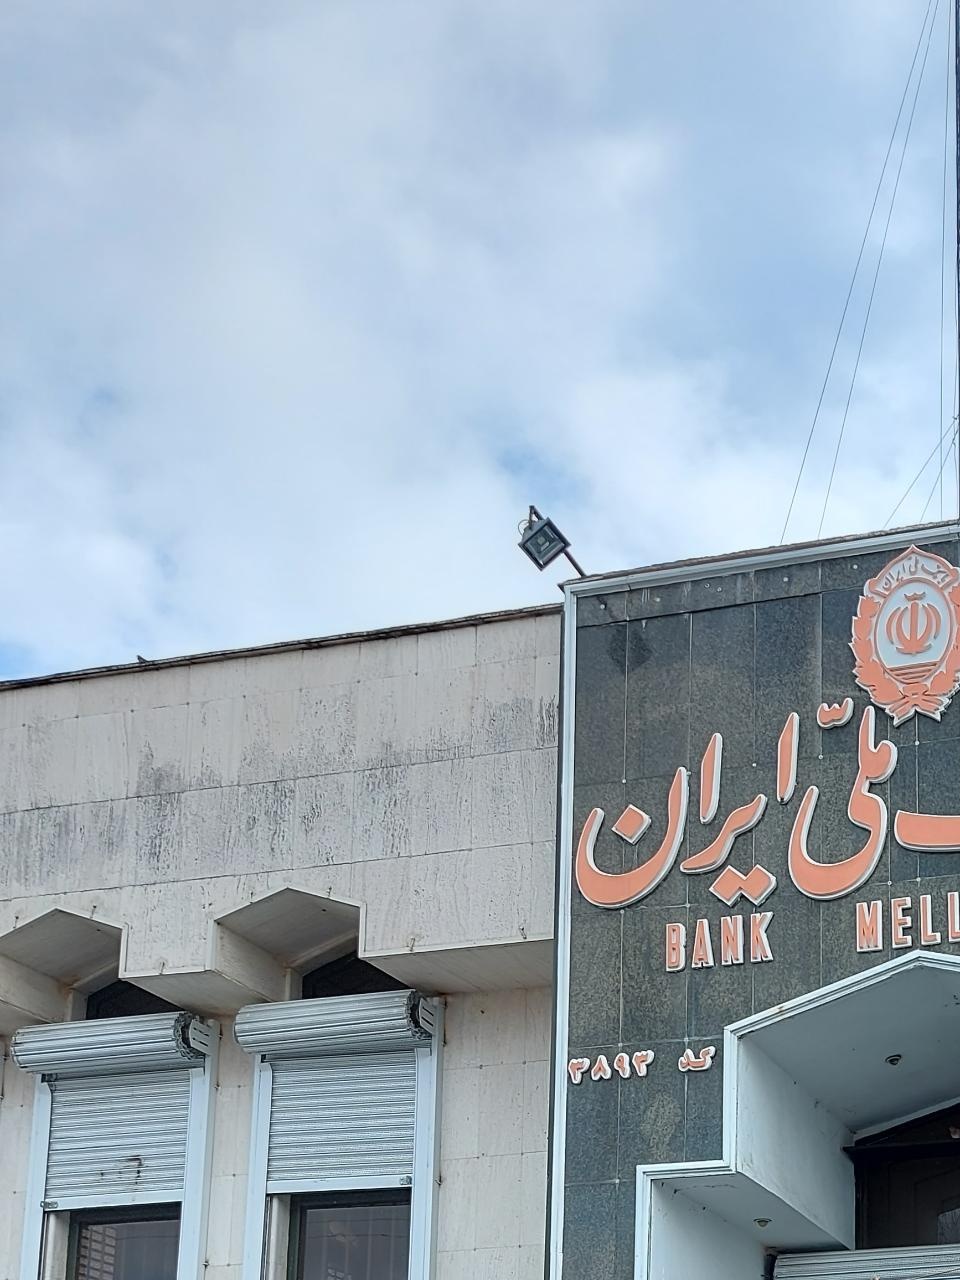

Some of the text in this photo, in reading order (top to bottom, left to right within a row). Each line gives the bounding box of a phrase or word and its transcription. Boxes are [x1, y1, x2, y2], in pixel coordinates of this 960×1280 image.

[575, 711, 800, 910] ایران
[664, 911, 774, 973] BANK
[568, 1045, 716, 1084] کد ۳۸۹۳
